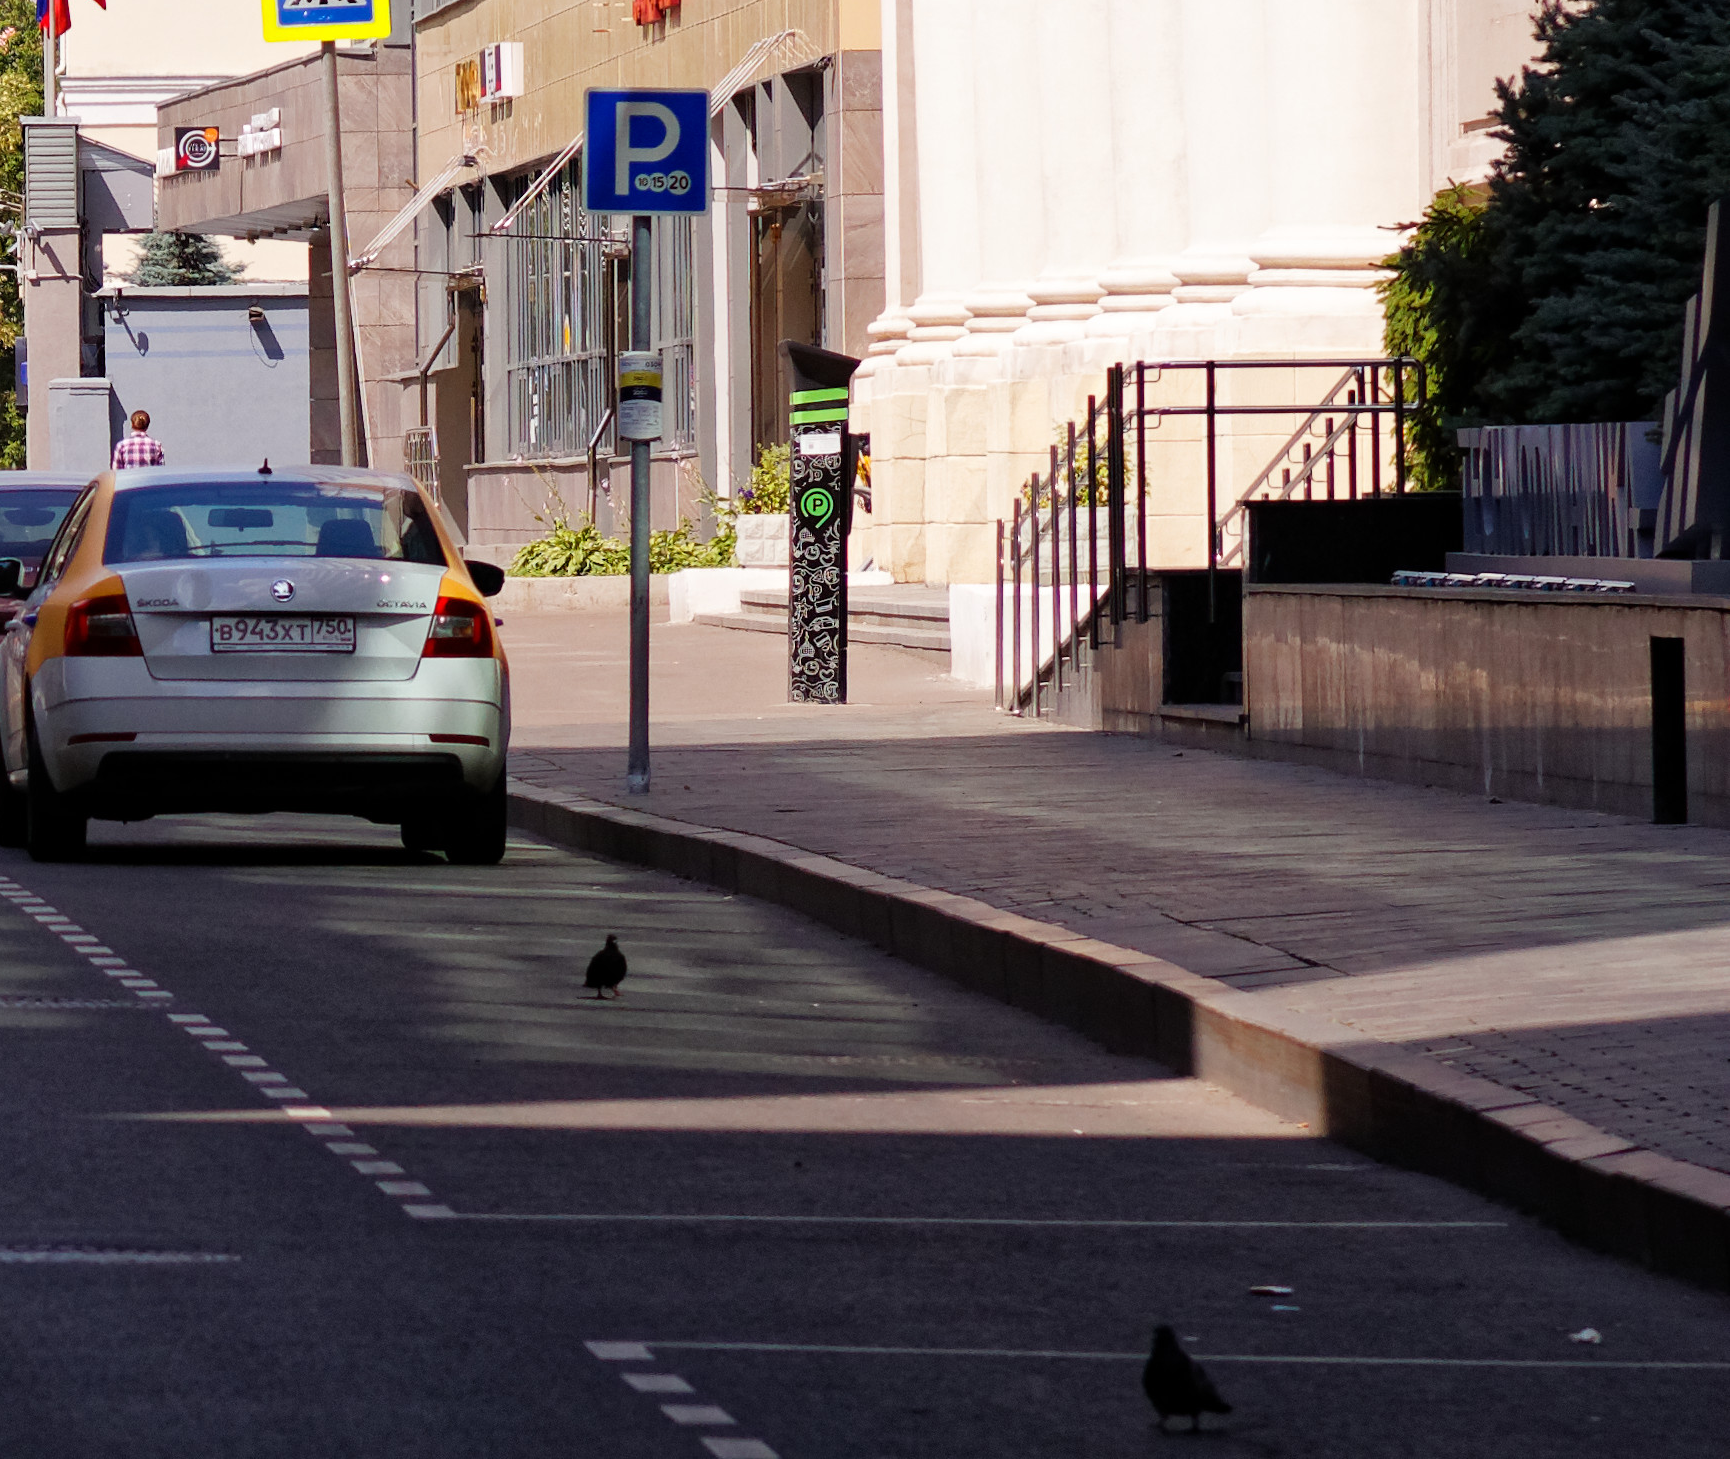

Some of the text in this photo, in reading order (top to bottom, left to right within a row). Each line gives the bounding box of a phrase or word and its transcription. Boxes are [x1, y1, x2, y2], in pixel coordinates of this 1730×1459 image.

[615, 101, 680, 195] P
[638, 175, 689, 190] 10 15 20
[812, 498, 824, 513] P
[376, 600, 427, 608] OCTAVIA
[219, 618, 348, 642] В943ХТ 750
